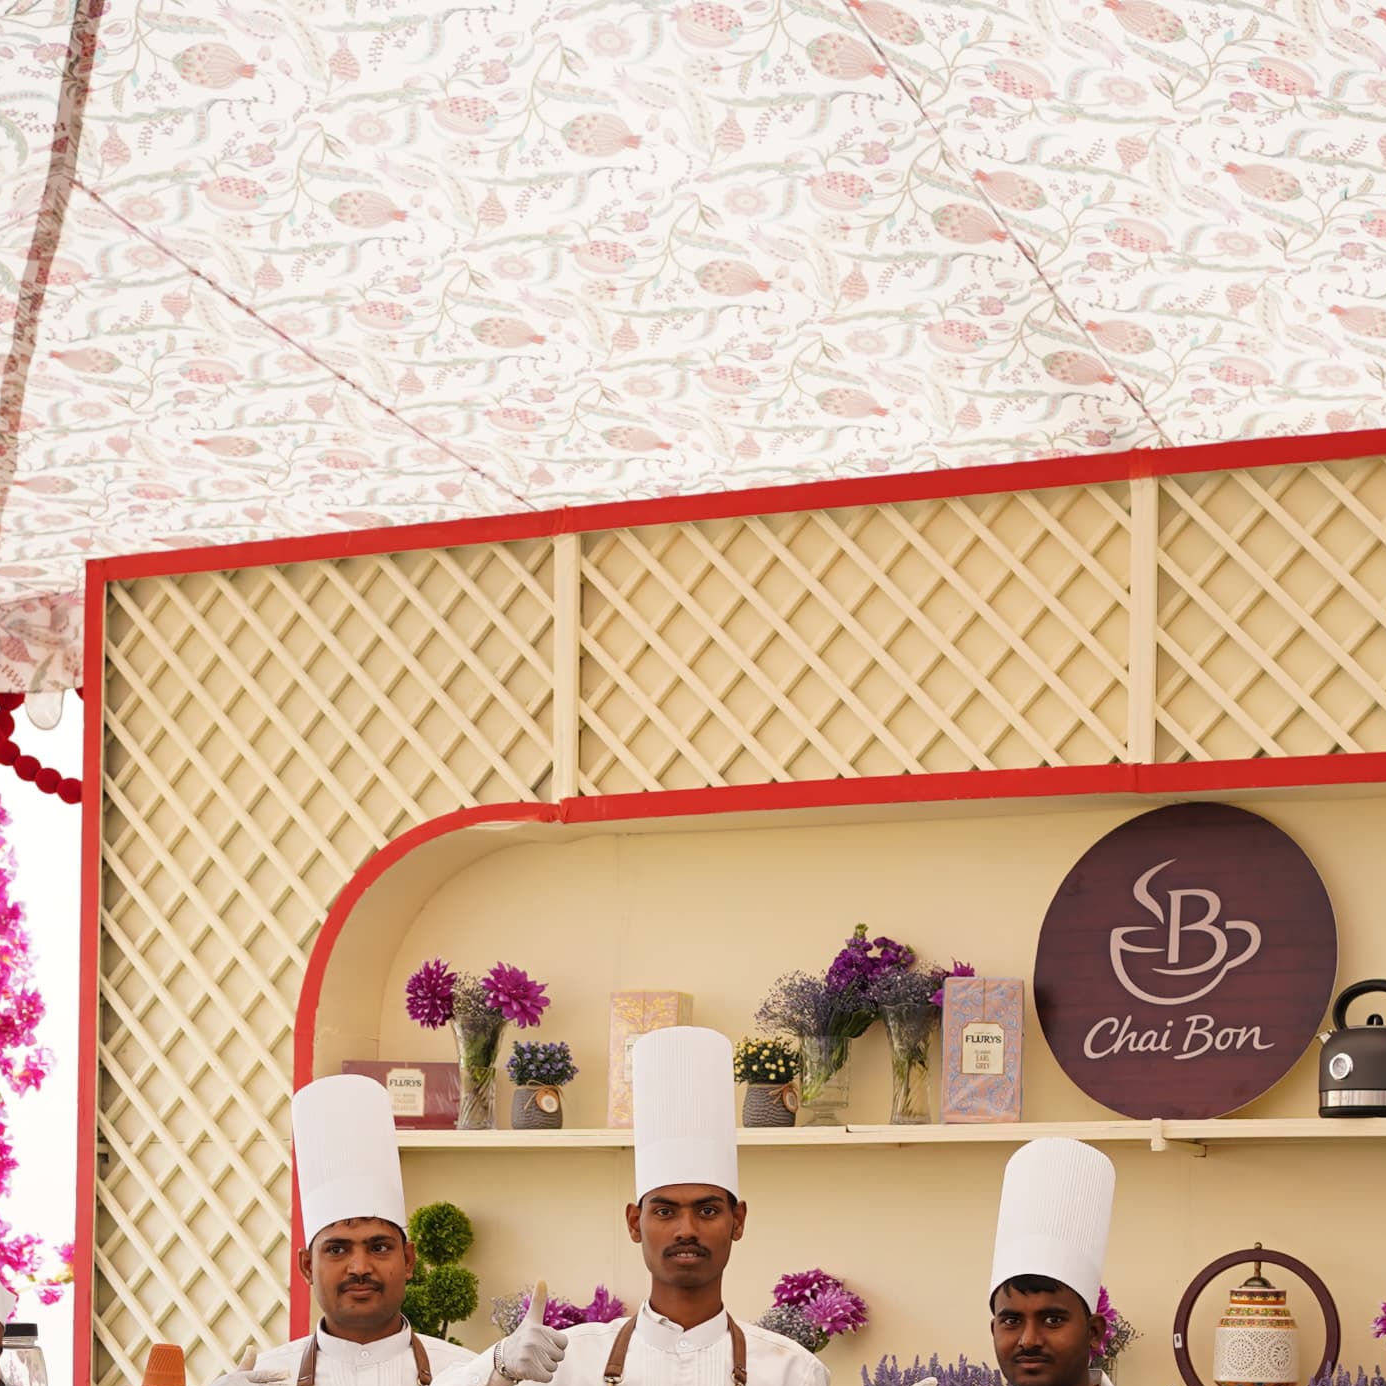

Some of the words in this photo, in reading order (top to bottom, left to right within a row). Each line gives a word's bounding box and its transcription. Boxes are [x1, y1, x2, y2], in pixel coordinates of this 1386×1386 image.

[965, 1034, 1002, 1044] FLURYS
[1083, 1014, 1173, 1059] Chai
[1173, 1014, 1276, 1060] Bon
[389, 1079, 422, 1087] FLURYS
